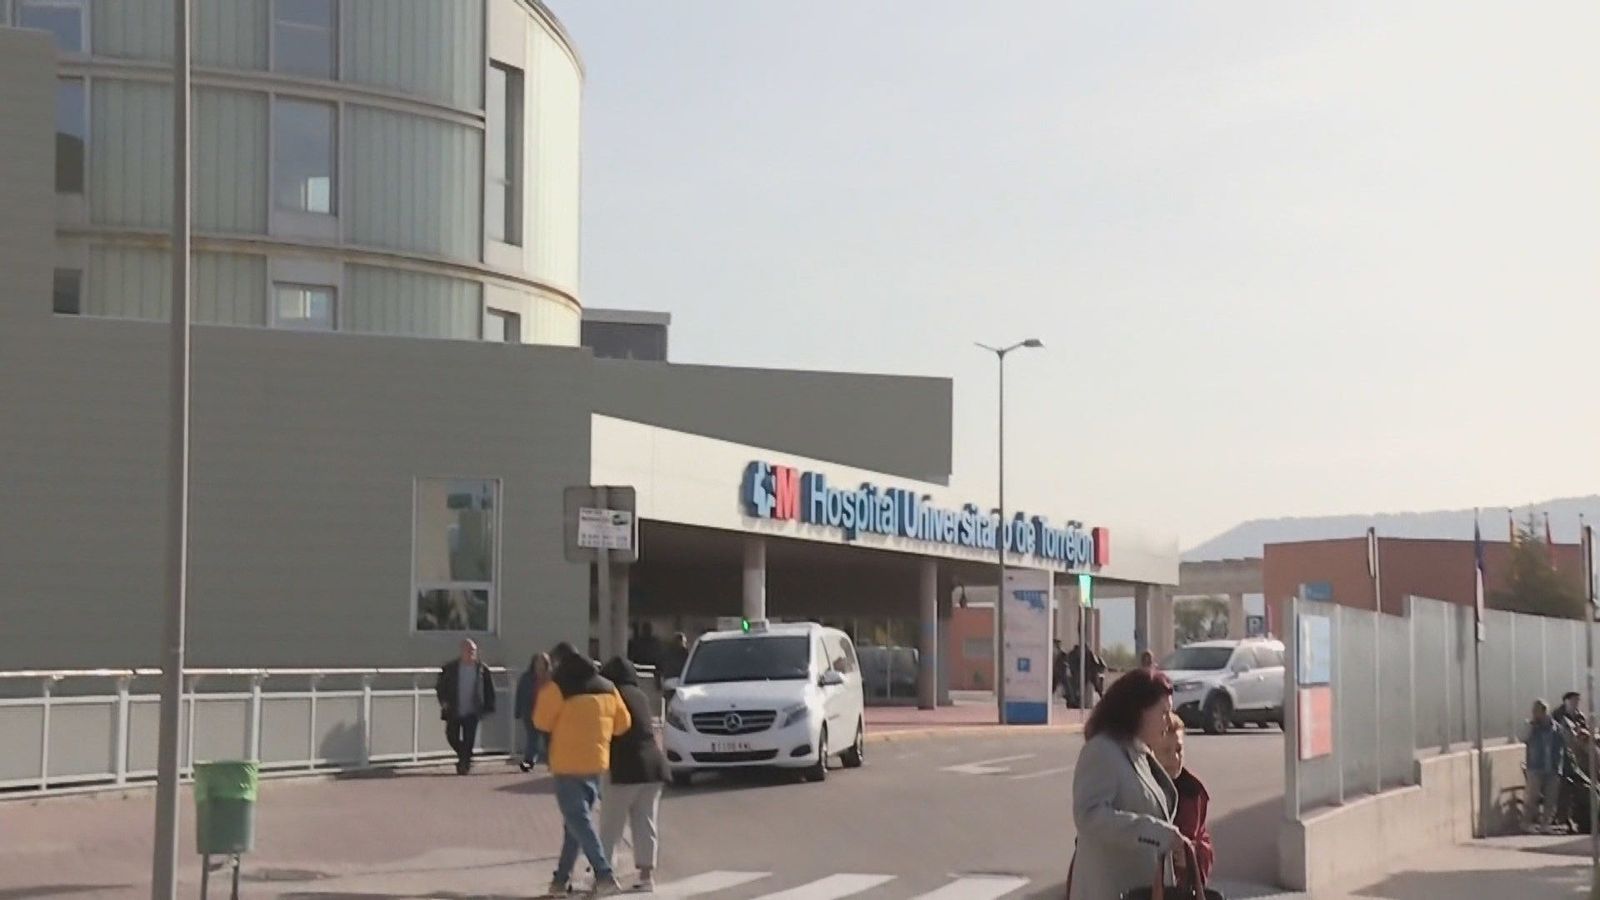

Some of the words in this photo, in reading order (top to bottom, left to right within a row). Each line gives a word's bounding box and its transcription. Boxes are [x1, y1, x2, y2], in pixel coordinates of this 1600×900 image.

[805, 471, 900, 540] Hospital
[903, 489, 1013, 550] Universitaro
[1014, 512, 1036, 554] de
